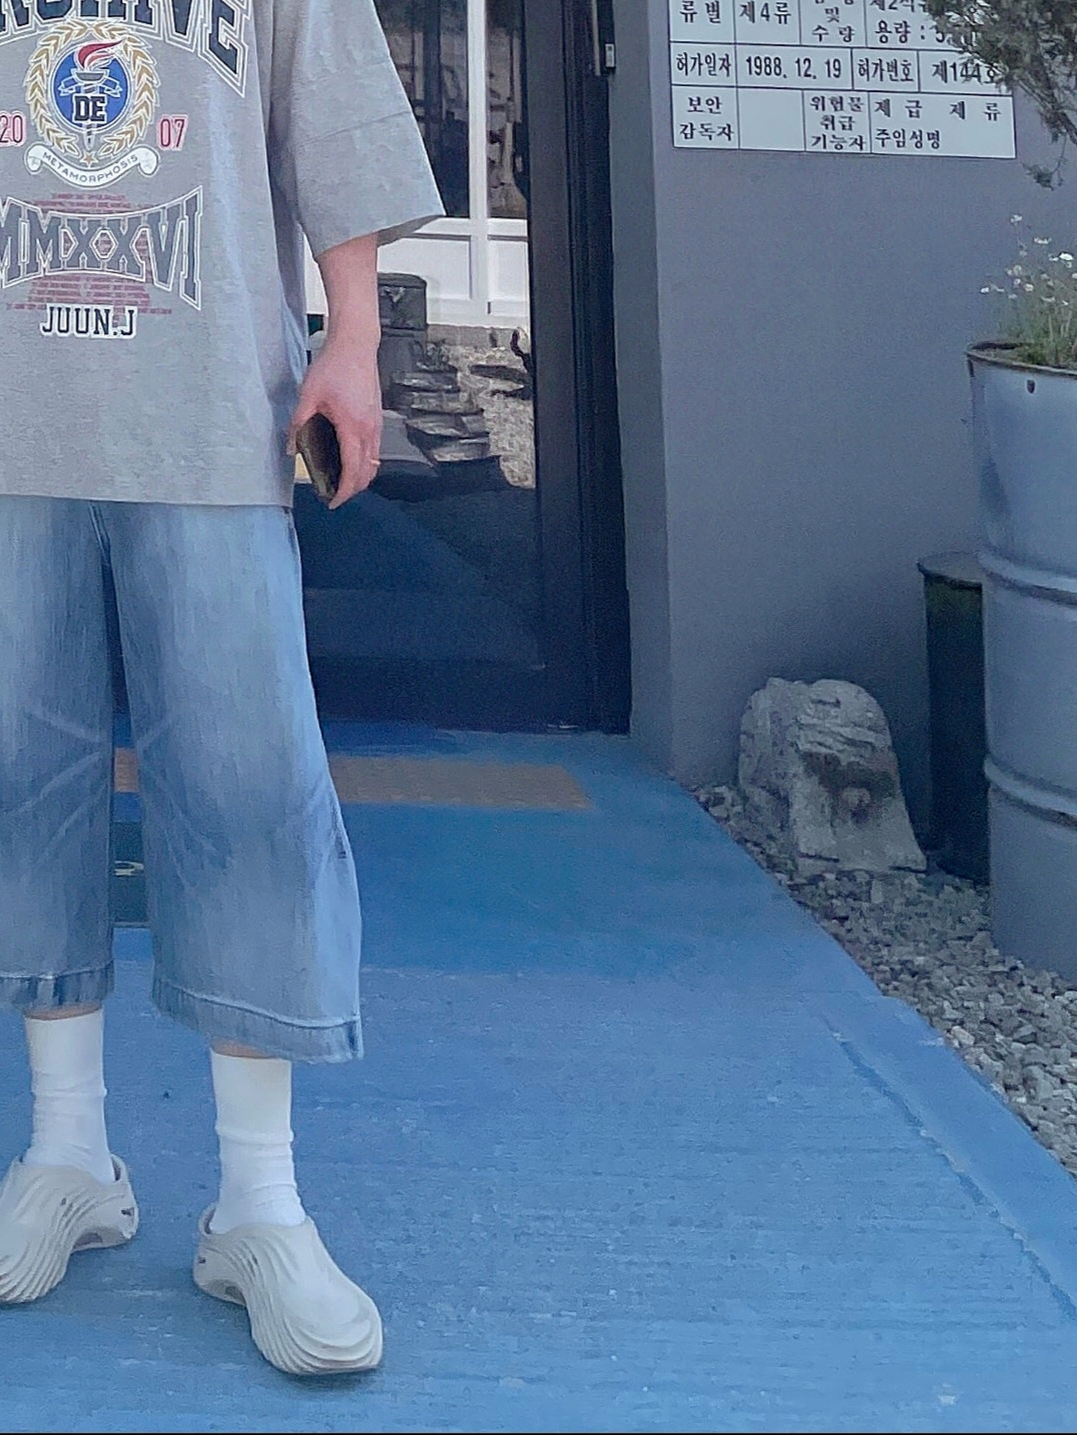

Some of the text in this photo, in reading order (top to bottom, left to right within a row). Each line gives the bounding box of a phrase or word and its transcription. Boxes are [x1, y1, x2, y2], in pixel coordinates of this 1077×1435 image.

[739, 1, 792, 24] 제4류
[675, 51, 732, 77] 허가일자
[745, 56, 842, 80] 1988. 12. 19
[858, 58, 915, 82] 허가번호
[74, 95, 107, 123] DE
[687, 96, 722, 114] 보안
[809, 95, 865, 113] 위험물
[158, 118, 187, 149] 07
[679, 124, 734, 143] 감독자
[819, 115, 857, 131] 취급
[809, 134, 867, 151] 기능자
[874, 128, 942, 150] 주임성명
[42, 151, 139, 183] METAMORPHOSIS
[41, 305, 136, 336] JUUN.J
